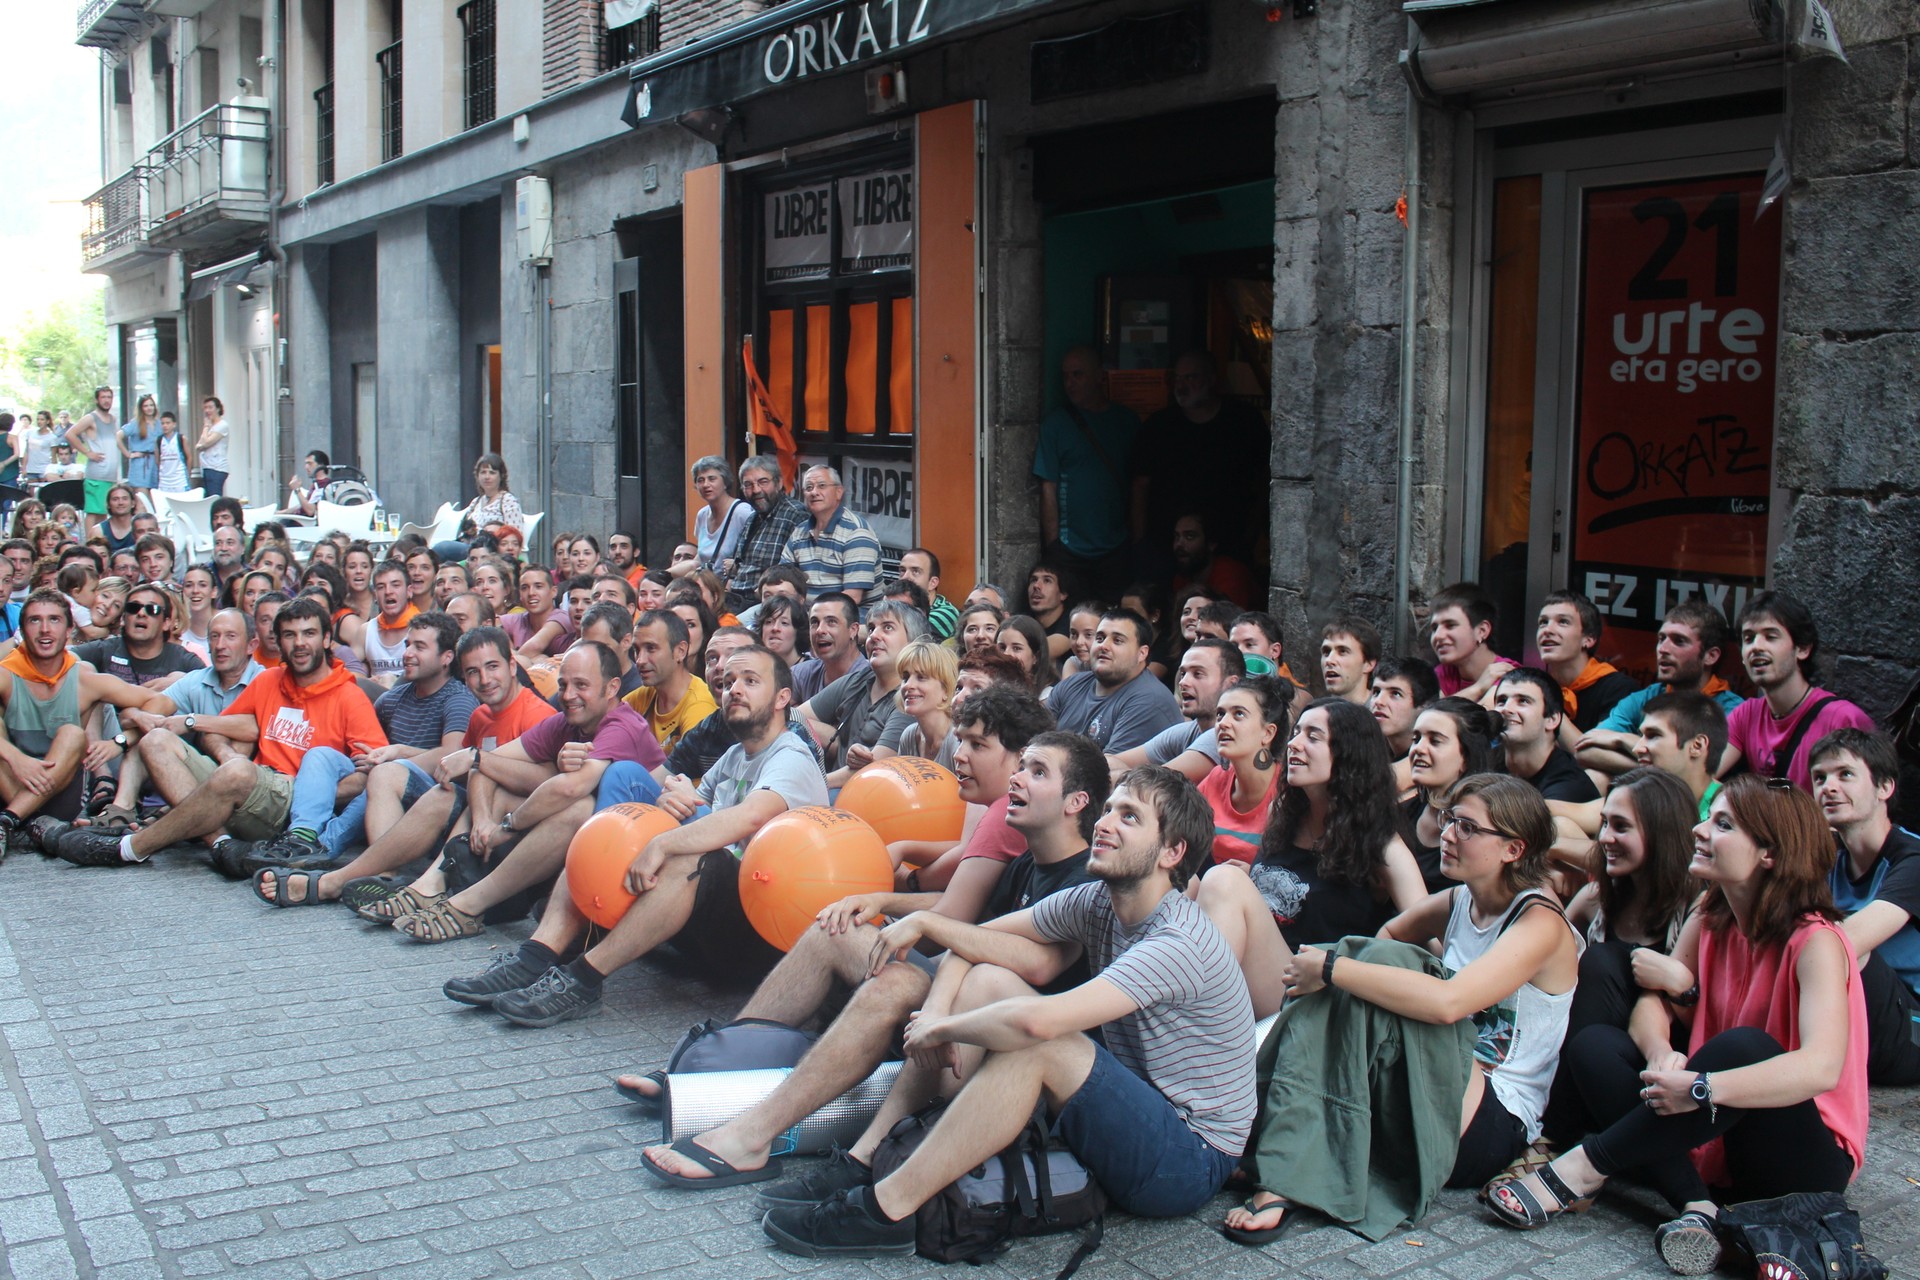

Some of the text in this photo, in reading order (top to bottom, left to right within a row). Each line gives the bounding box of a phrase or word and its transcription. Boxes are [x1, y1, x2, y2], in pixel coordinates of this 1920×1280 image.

[764, 0, 930, 83] ORKATZ
[774, 189, 827, 239] LIBRE
[853, 173, 912, 227] LIBRE
[1628, 191, 1739, 301] 21
[1613, 301, 1765, 355] urte
[1610, 356, 1762, 393] eta gero
[1587, 414, 1767, 500] ORKATZ
[851, 466, 912, 518] LIBRE
[1585, 572, 1638, 618] EZ
